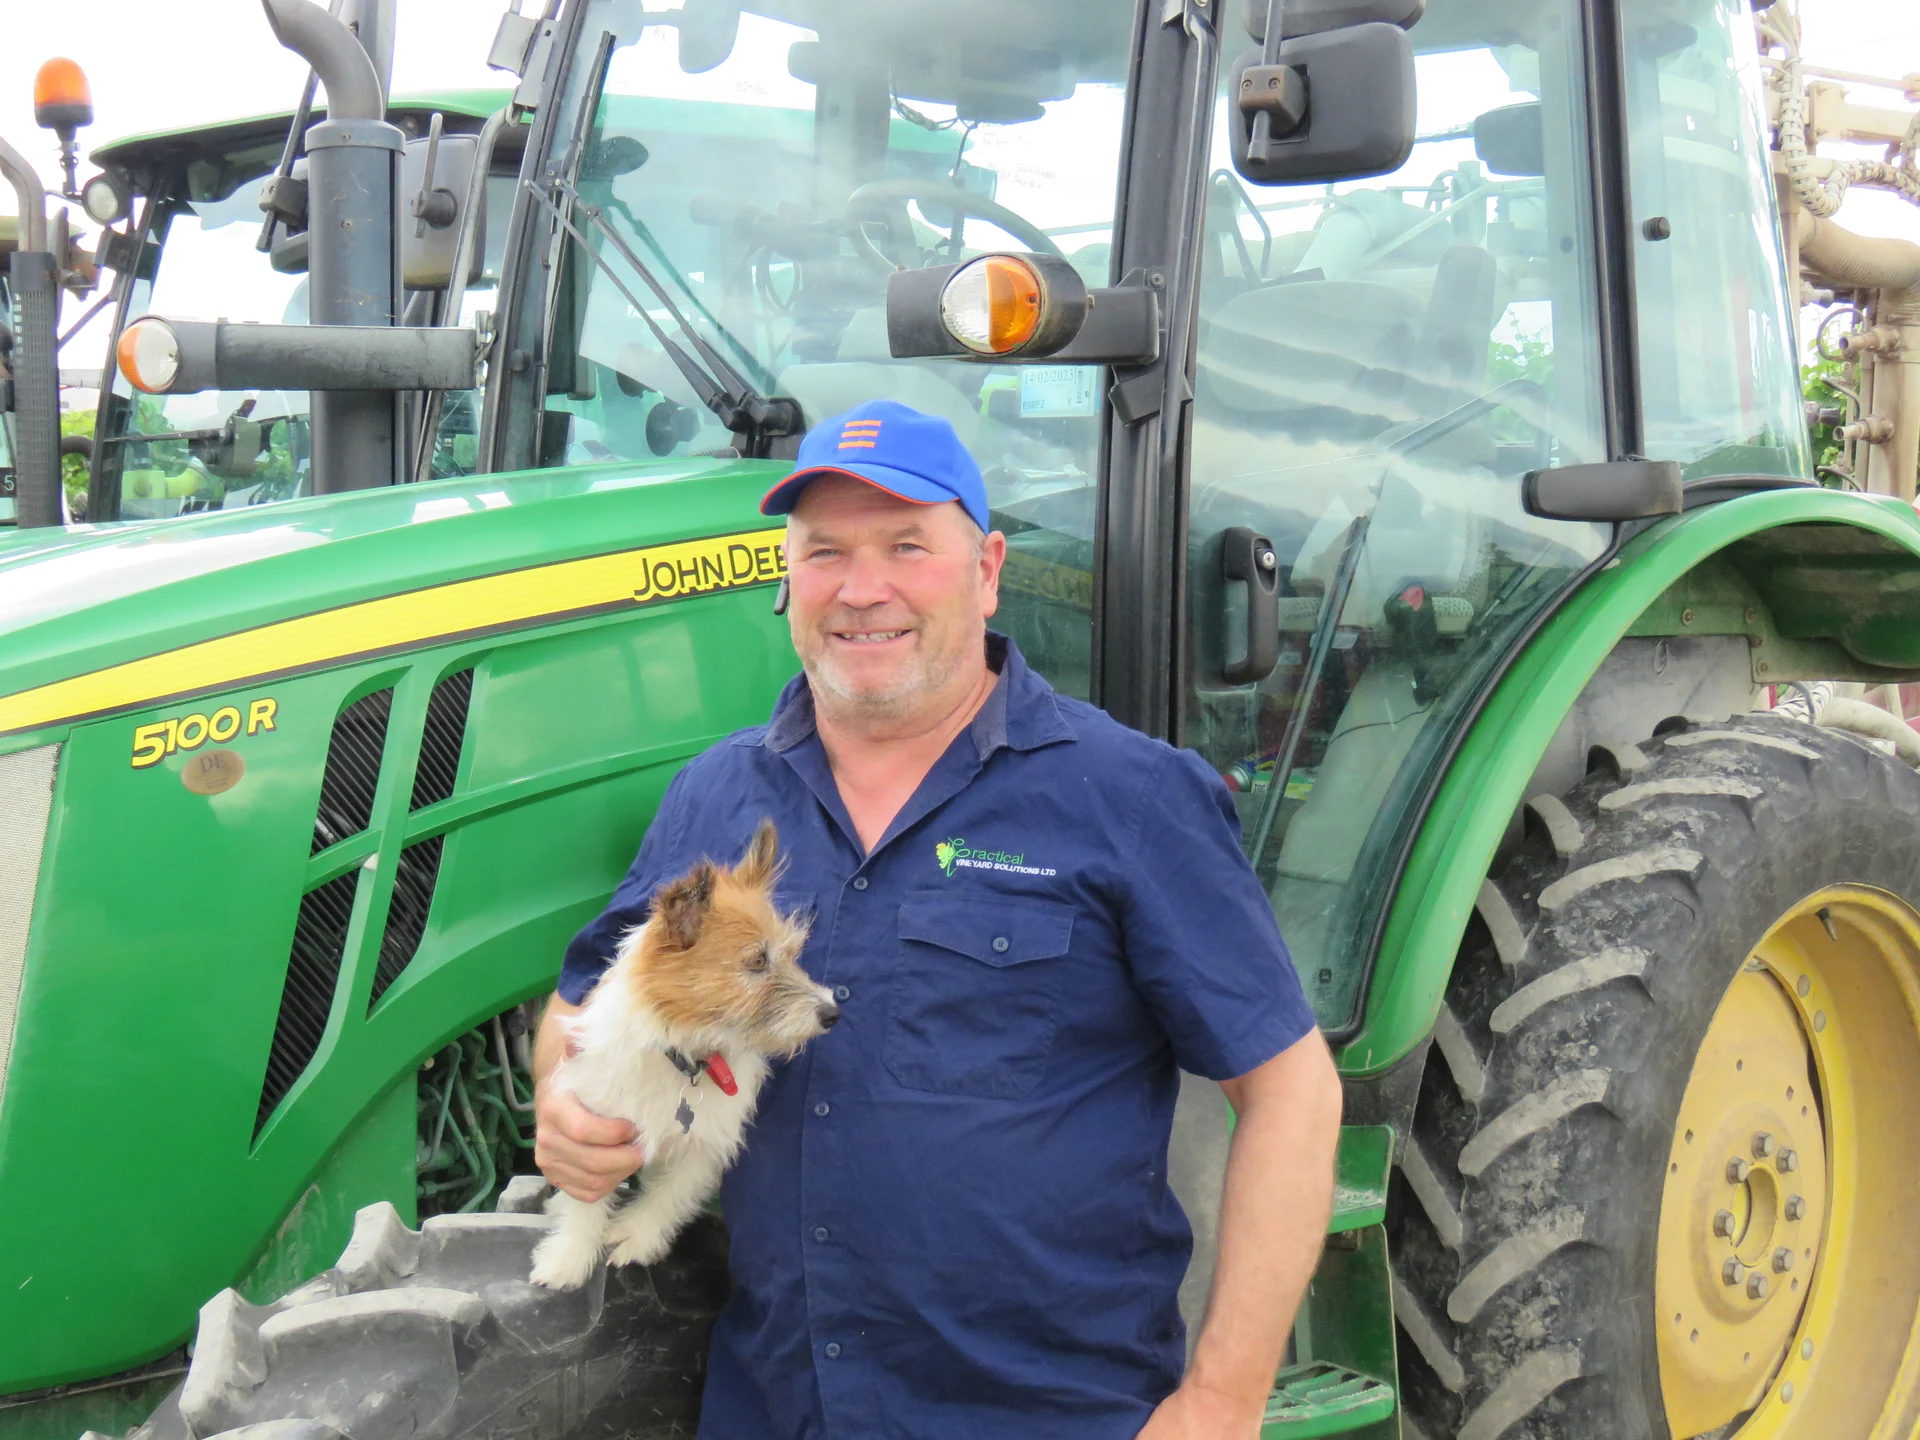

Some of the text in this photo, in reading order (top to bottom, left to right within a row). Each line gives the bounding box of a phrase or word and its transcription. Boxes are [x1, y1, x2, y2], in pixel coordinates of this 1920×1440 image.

[4, 474, 18, 491] 5
[634, 543, 788, 597] JOHN DEE
[131, 697, 279, 770] 5100 R
[955, 858, 1056, 876] VINEYARD SOLUTIONS LTD
